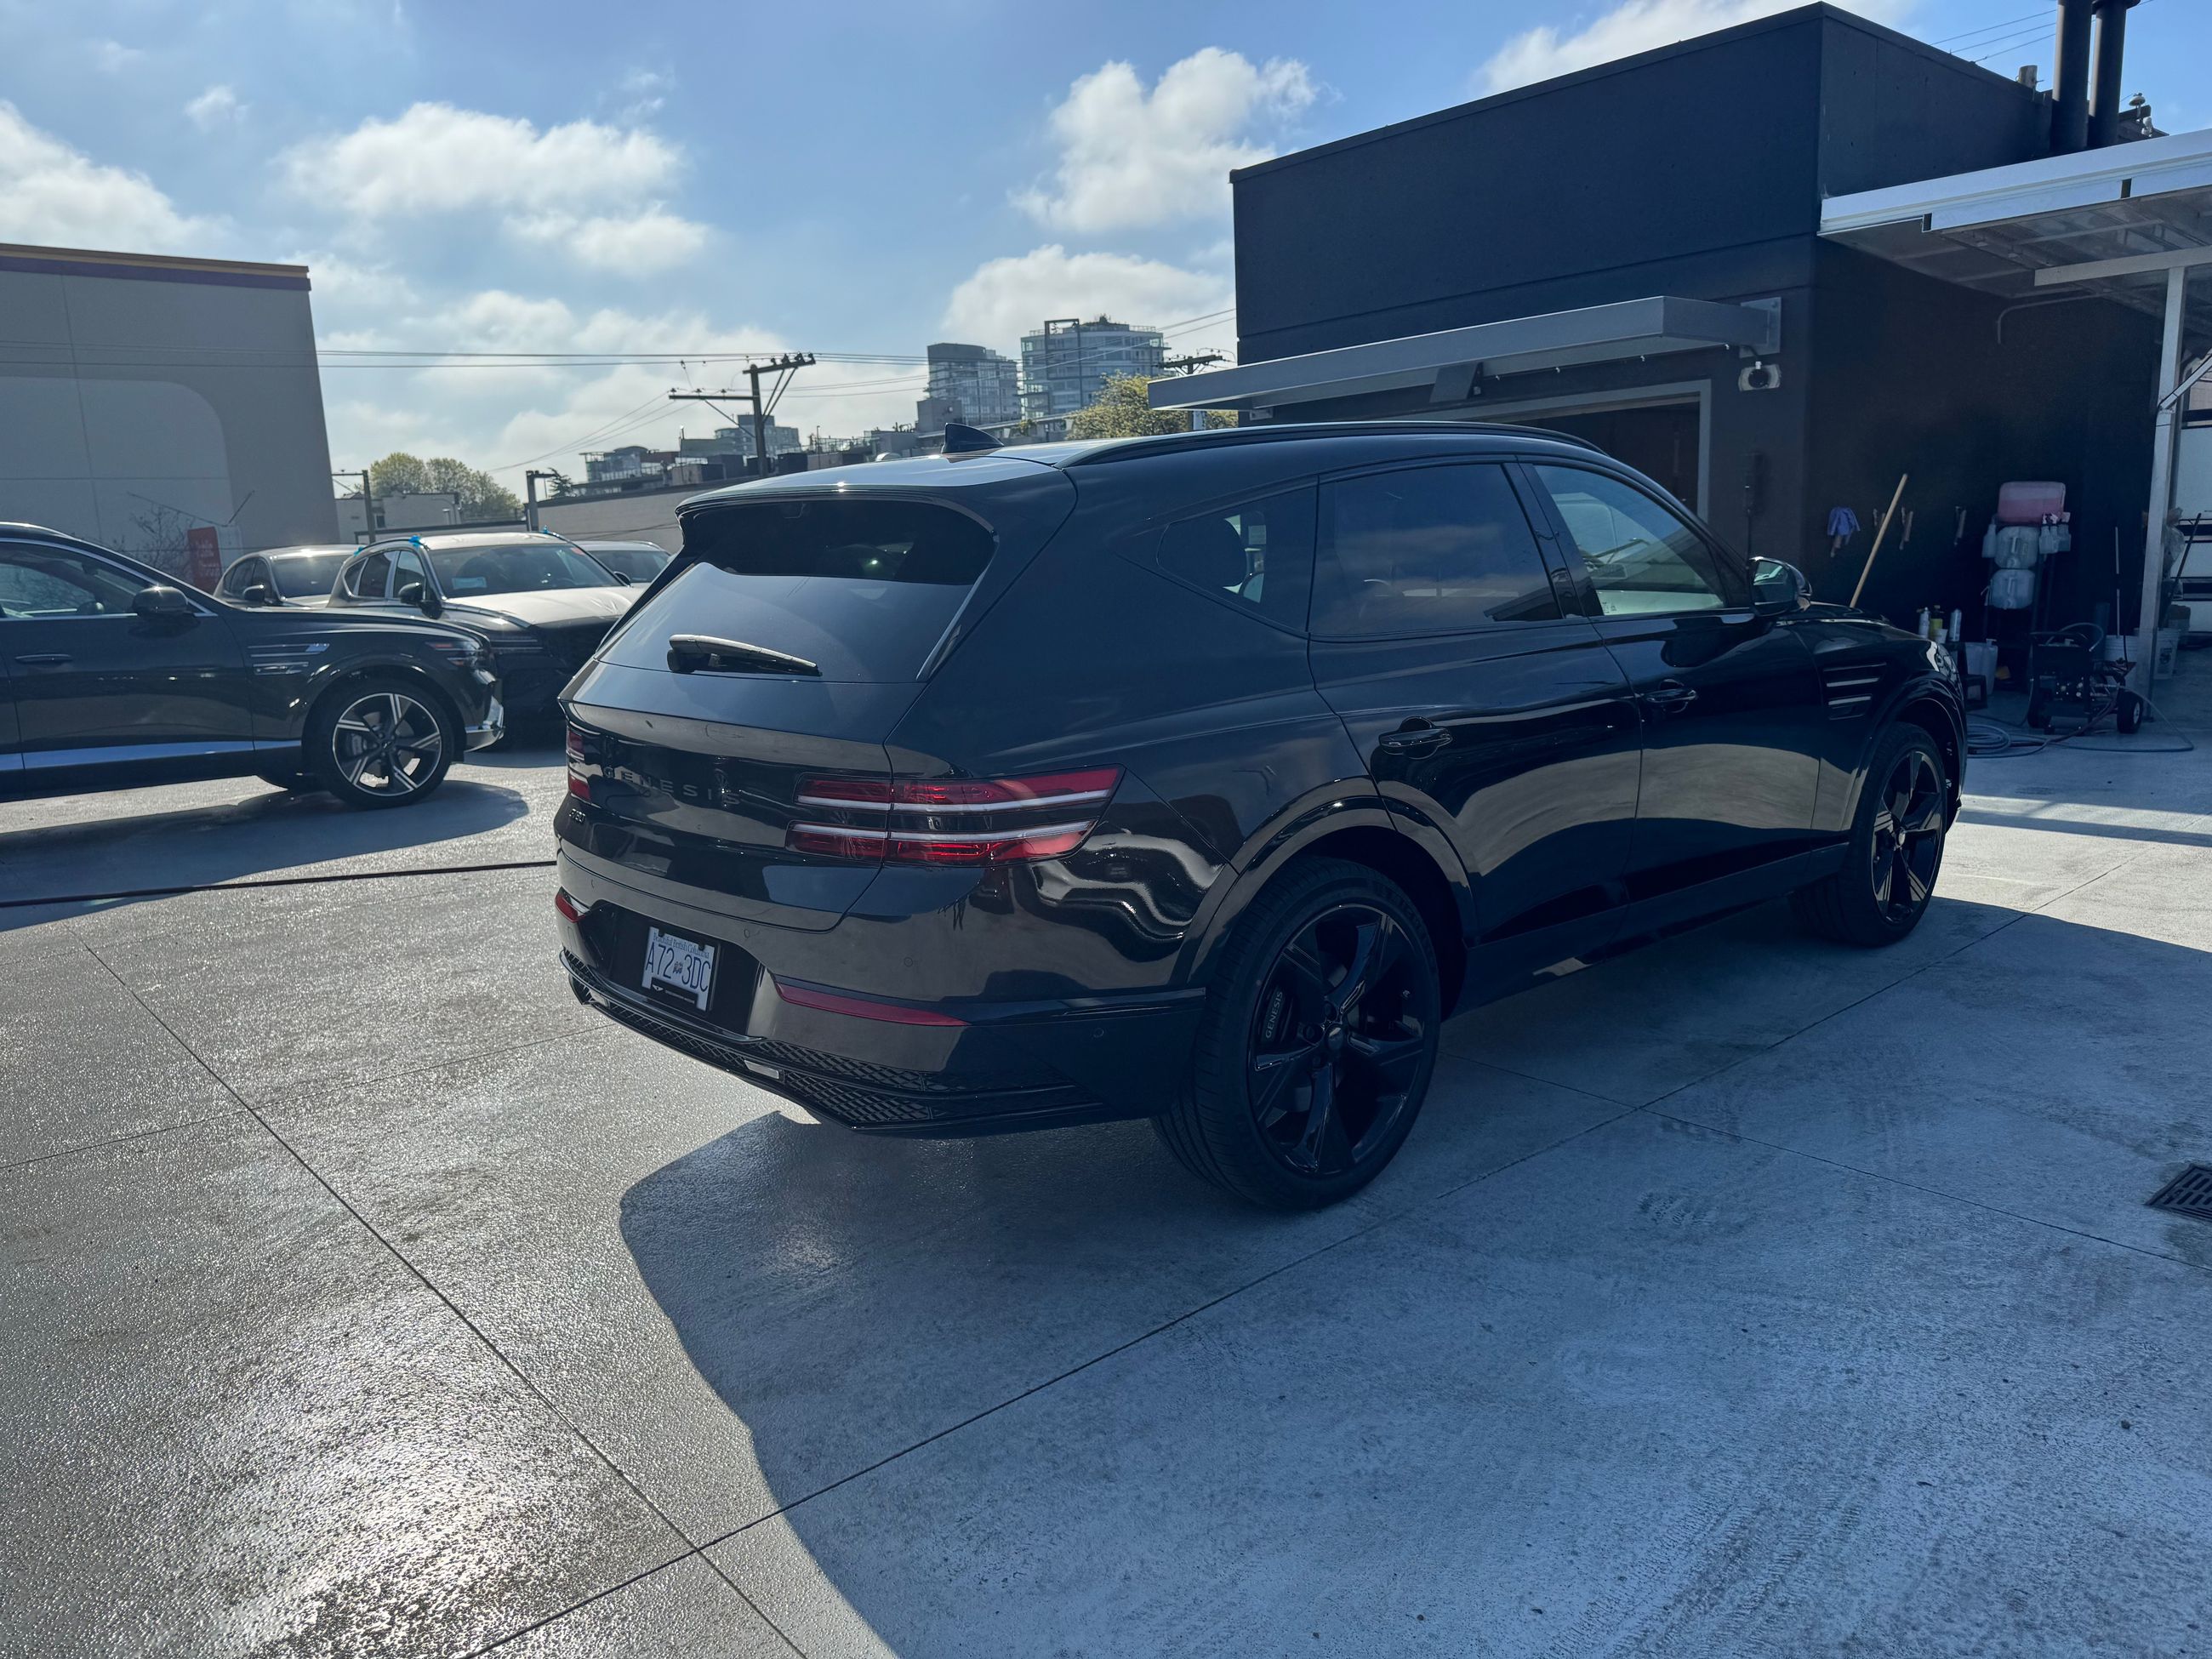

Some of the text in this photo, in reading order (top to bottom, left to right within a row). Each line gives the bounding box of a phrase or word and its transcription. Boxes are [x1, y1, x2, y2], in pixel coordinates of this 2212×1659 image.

[603, 767, 741, 806] GENESIS
[645, 942, 711, 992] A72 3DC
[1265, 991, 1283, 1039] GENESIS
